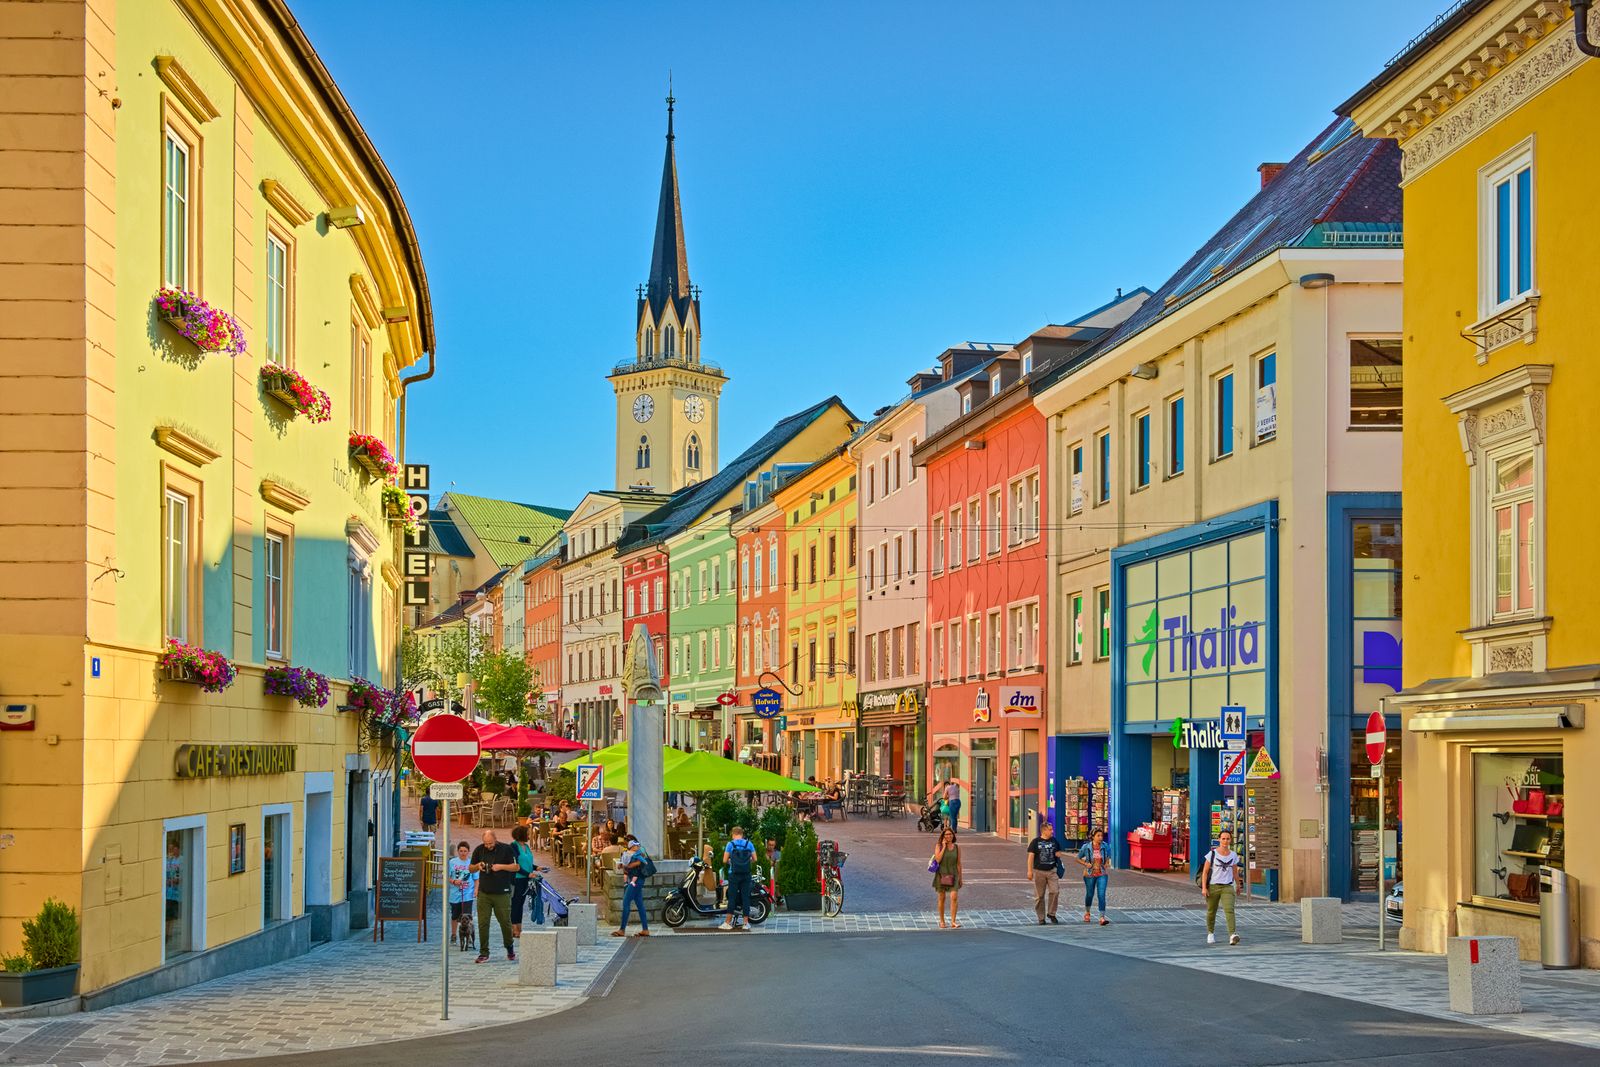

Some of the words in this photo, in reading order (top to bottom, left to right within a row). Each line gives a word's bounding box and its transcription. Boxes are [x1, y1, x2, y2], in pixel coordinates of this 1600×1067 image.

[408, 466, 427, 604] HOTEL
[1163, 605, 1258, 673] Thalia
[94, 660, 99, 672] 1
[976, 688, 988, 709] dm
[1010, 691, 1034, 706] dm
[1181, 721, 1224, 749] Thalia
[229, 744, 298, 776] RESTAURANT
